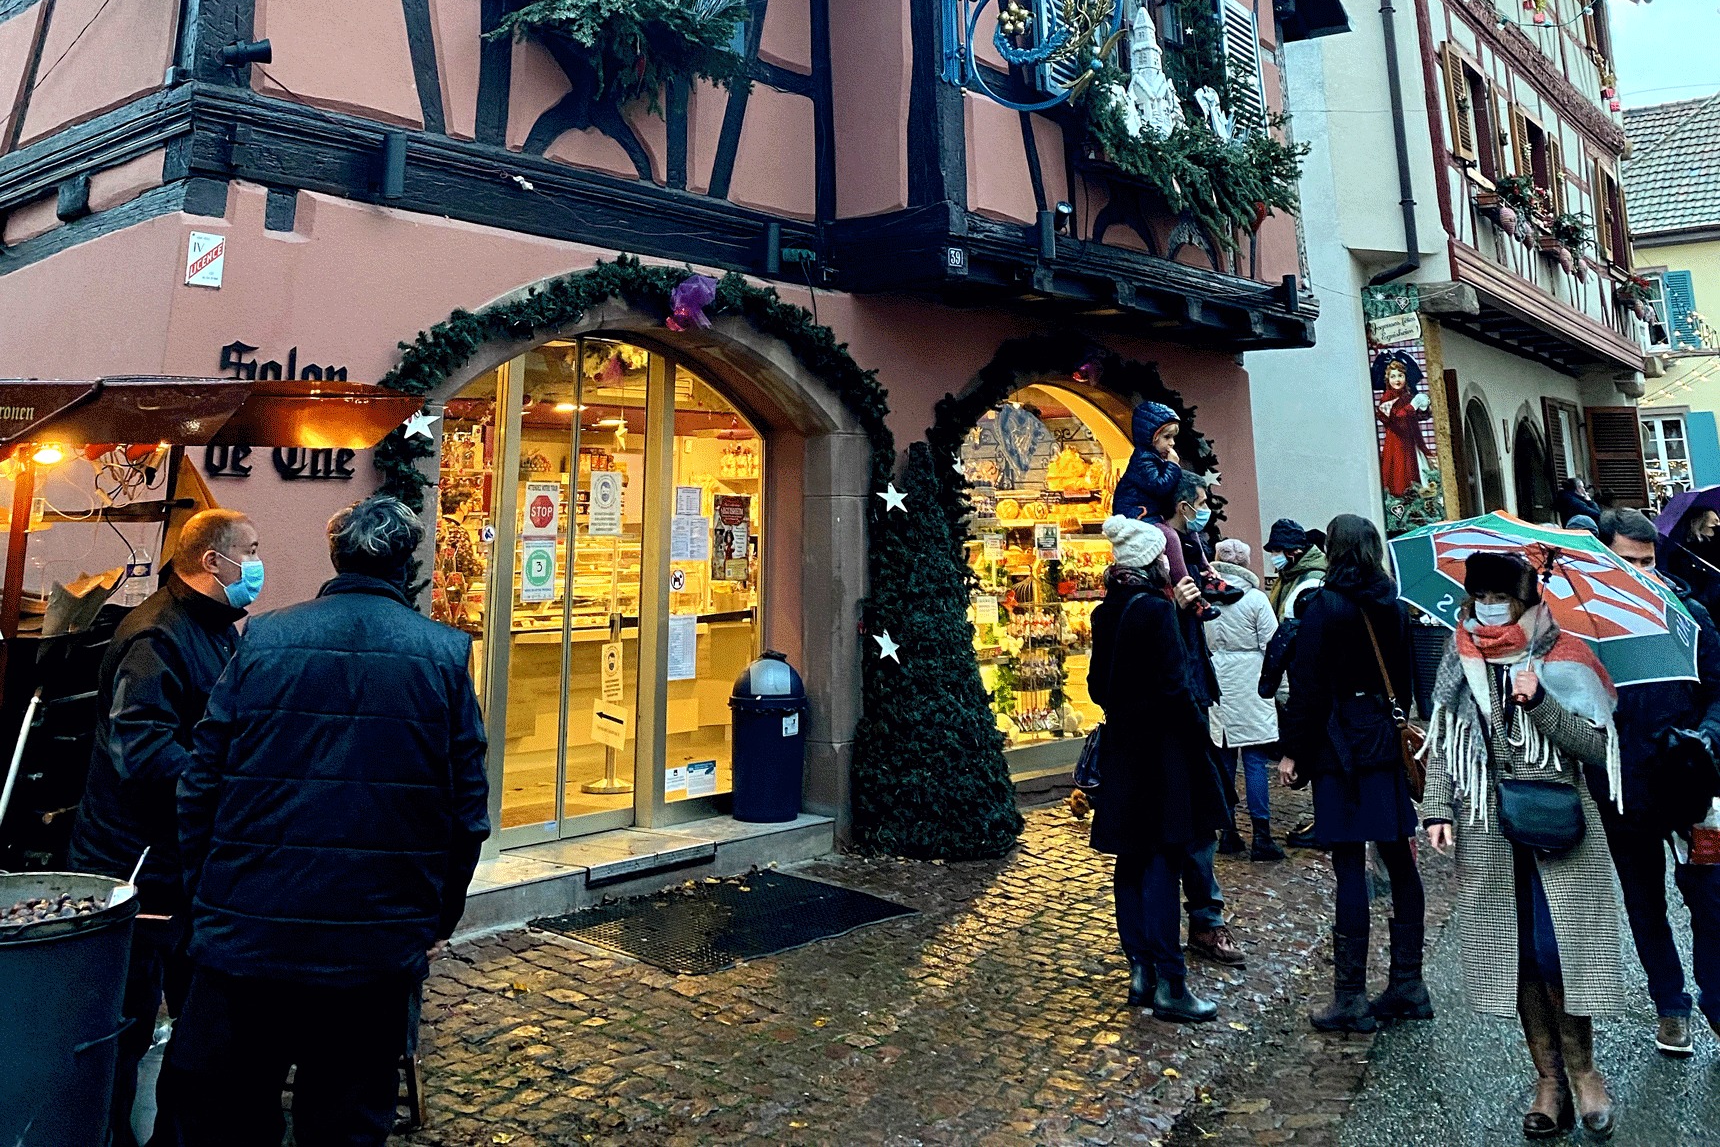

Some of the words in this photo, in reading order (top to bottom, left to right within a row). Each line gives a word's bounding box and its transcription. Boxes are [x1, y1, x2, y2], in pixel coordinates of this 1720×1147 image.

[193, 241, 206, 253] IV
[189, 244, 223, 277] LICENCE
[950, 250, 960, 264] 39
[531, 506, 553, 518] STOP
[536, 561, 543, 573] 3
